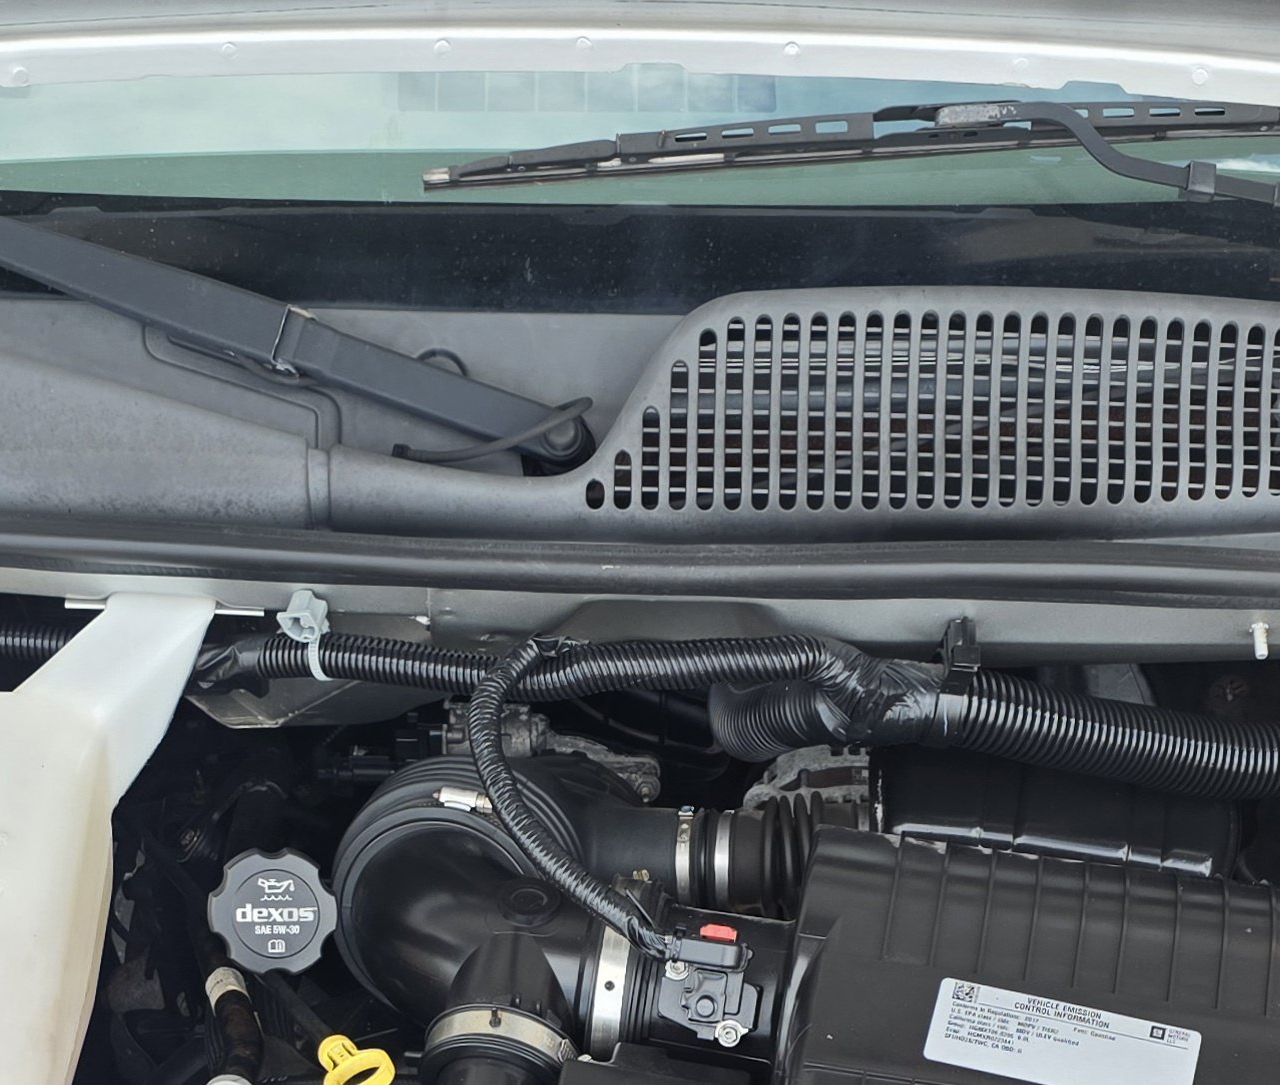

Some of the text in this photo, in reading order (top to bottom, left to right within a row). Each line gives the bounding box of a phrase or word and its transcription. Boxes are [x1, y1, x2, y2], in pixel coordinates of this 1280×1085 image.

[236, 903, 316, 922] dexos
[254, 925, 300, 934] SAE 5W-30
[1014, 1002, 1110, 1030] CONTROL INFORMATION
[1027, 997, 1102, 1020] VEHICLE EMISSION
